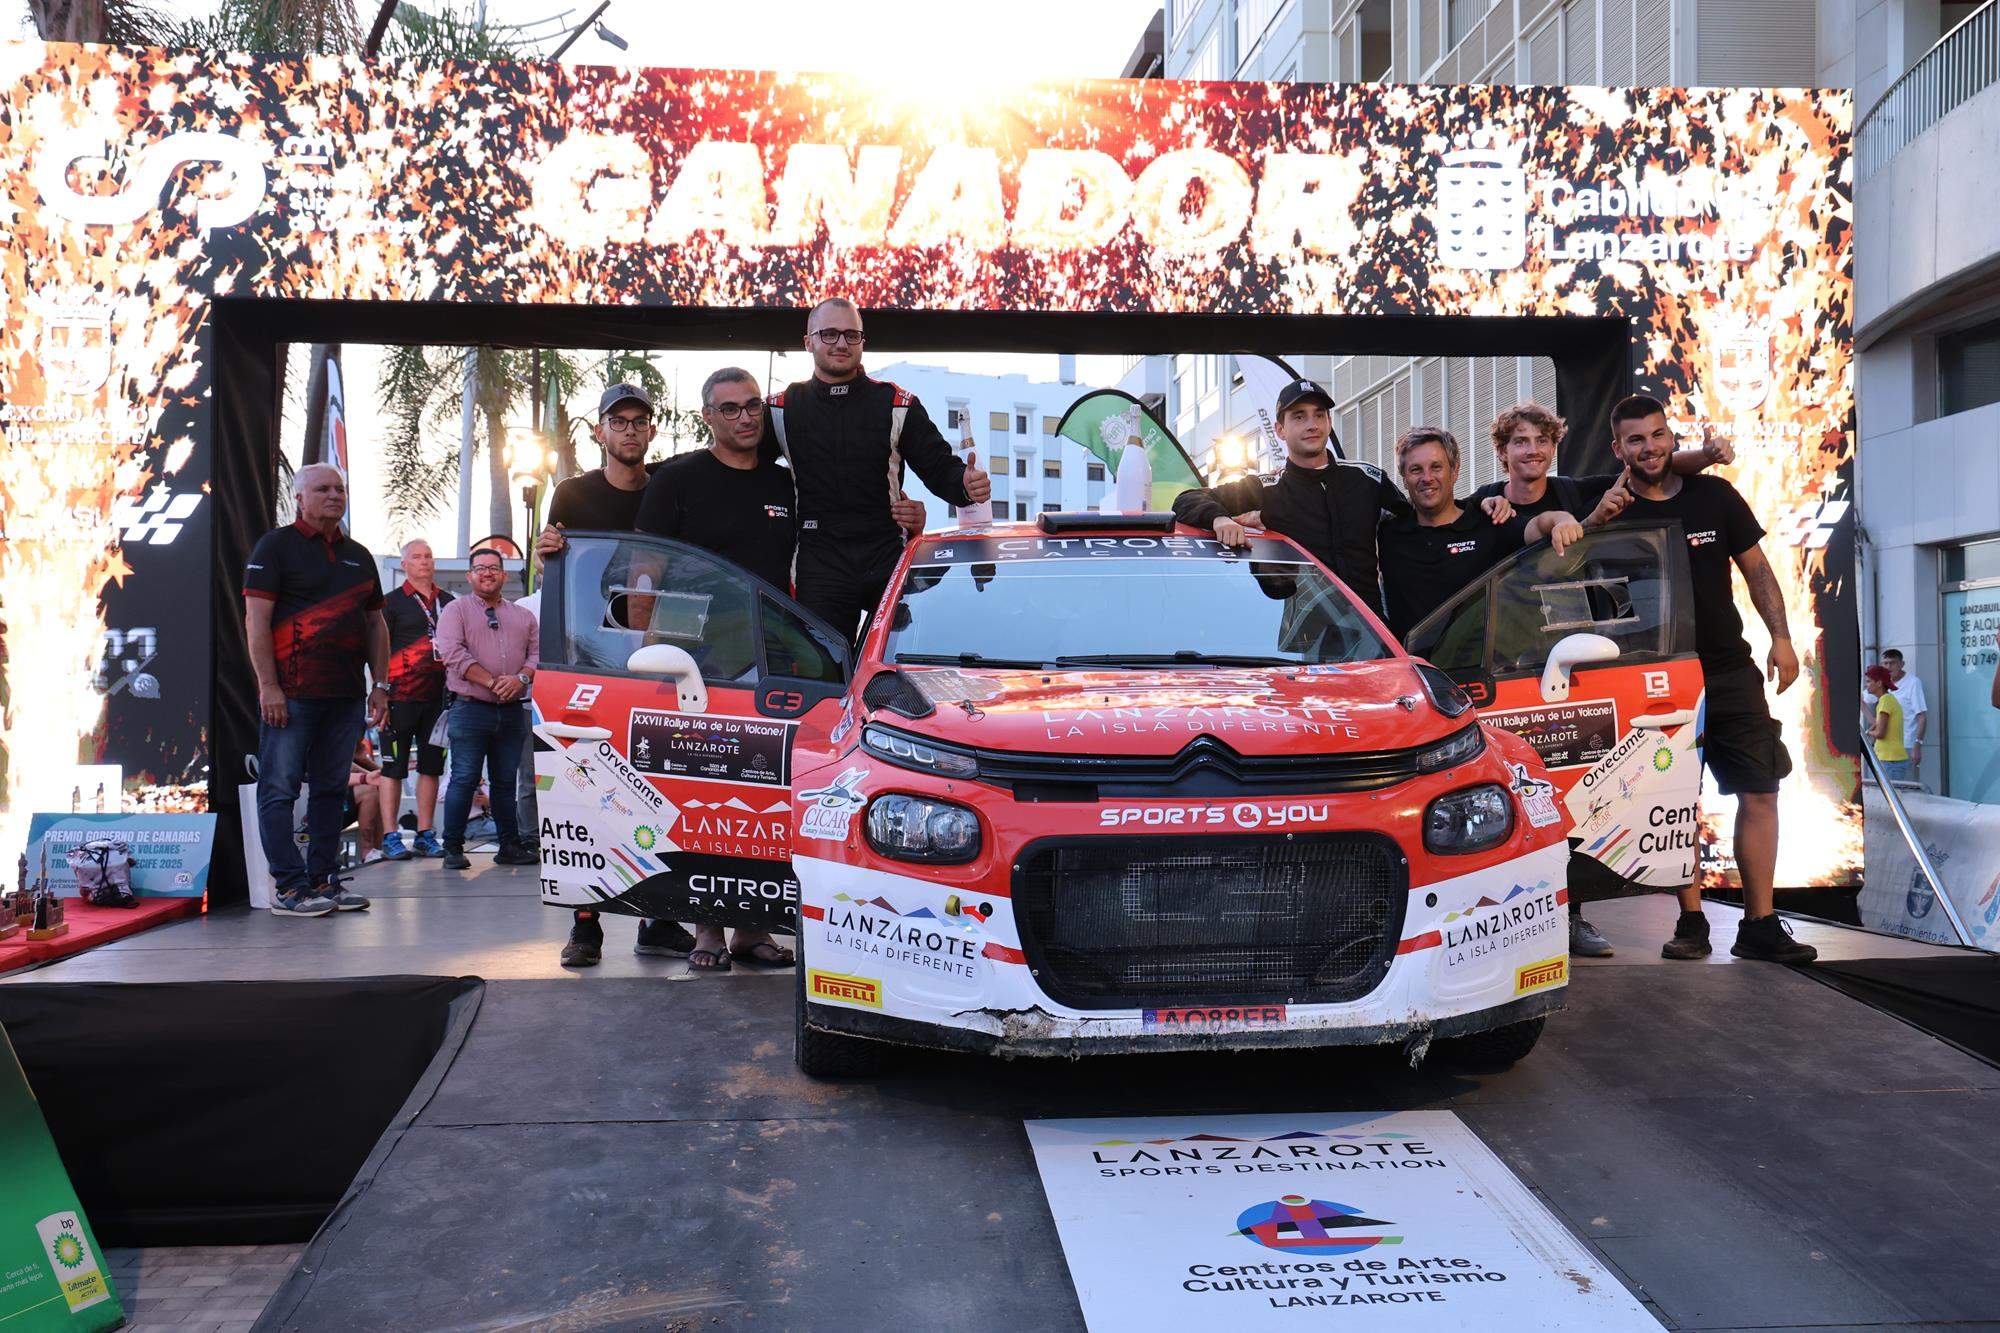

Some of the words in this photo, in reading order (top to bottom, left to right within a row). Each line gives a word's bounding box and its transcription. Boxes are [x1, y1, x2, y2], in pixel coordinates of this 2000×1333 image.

[1543, 223, 1753, 262] Lanzarote
[1447, 540, 1475, 549] SPORTS
[1687, 530, 1716, 540] SPORTS
[1960, 619, 1971, 632] SE
[1960, 635, 1977, 648] 928
[1979, 633, 1997, 647] 807
[1961, 654, 1978, 666] 670
[1980, 652, 1998, 665] 749
[765, 690, 803, 711] C3
[634, 714, 663, 726] XXVII
[664, 718, 690, 731] Rallye
[692, 719, 707, 730] Isla
[710, 721, 723, 731] de
[726, 722, 741, 733] Los
[744, 723, 784, 737] Volcanes
[1504, 714, 1529, 728] Rallye
[1531, 711, 1545, 723] Isla
[1547, 711, 1559, 721] de
[1562, 710, 1575, 720] Los
[1578, 706, 1613, 717] Volcanes
[1047, 725, 1083, 740] LA
[1103, 721, 1170, 734] ISLA
[1188, 720, 1360, 739] DIFERENTE
[671, 740, 740, 755] LANZAROTE
[1656, 736, 1665, 746] bp
[1582, 727, 1646, 788] Orvecame
[598, 742, 663, 808] Orvecame
[1099, 806, 1226, 826] SPORTS
[1266, 804, 1328, 826] YOU
[1524, 796, 1556, 817] CICAR
[1649, 803, 1697, 827] Cent
[681, 815, 792, 841] LANZAR
[804, 807, 849, 830] CICAR
[1590, 811, 1612, 832] CICAR
[44, 830, 83, 843] PREMIO
[85, 830, 135, 843] GOBIERNO
[137, 831, 150, 842] DE
[152, 831, 201, 843] CANARIAS
[540, 817, 594, 846] Arte,
[654, 823, 664, 836] bp
[137, 845, 181, 855] VOLCANES
[683, 839, 701, 850] LA
[709, 841, 744, 854] ISLA
[1639, 830, 1696, 854] Cultu
[159, 859, 183, 869] 2025
[540, 878, 560, 896] TE
[1447, 894, 1554, 949] LANZAROTE
[1881, 918, 1937, 941] Ayuntamiento
[1938, 932, 1949, 944] de
[828, 907, 977, 960] LANZAROTE
[1448, 952, 1465, 967] LA
[1470, 941, 1497, 959] ISLA
[1503, 917, 1557, 948] DIFERENTE
[827, 931, 842, 945] LA
[849, 939, 879, 955] ISLA
[886, 947, 974, 978] DIFERENTE
[1519, 960, 1564, 990] PIRELLI
[814, 974, 876, 1003] PIRELLI
[1092, 1142, 1433, 1164] LANZAROTE
[1100, 1165, 1222, 1178] SPORTS
[1235, 1159, 1447, 1174] DESTINATION
[60, 1218, 74, 1229] bp
[5, 1266, 24, 1279] Cerca
[24, 1264, 32, 1273] de
[1188, 1261, 1335, 1278] Centros
[1343, 1259, 1385, 1273] de
[1394, 1256, 1483, 1271] Arte,
[15, 1278, 28, 1287] más
[28, 1272, 44, 1283] lejos
[1182, 1277, 1323, 1293] Cultura
[1329, 1276, 1350, 1291] y
[1355, 1271, 1507, 1287] Turismo
[1268, 1290, 1448, 1308] LANZAROTE
